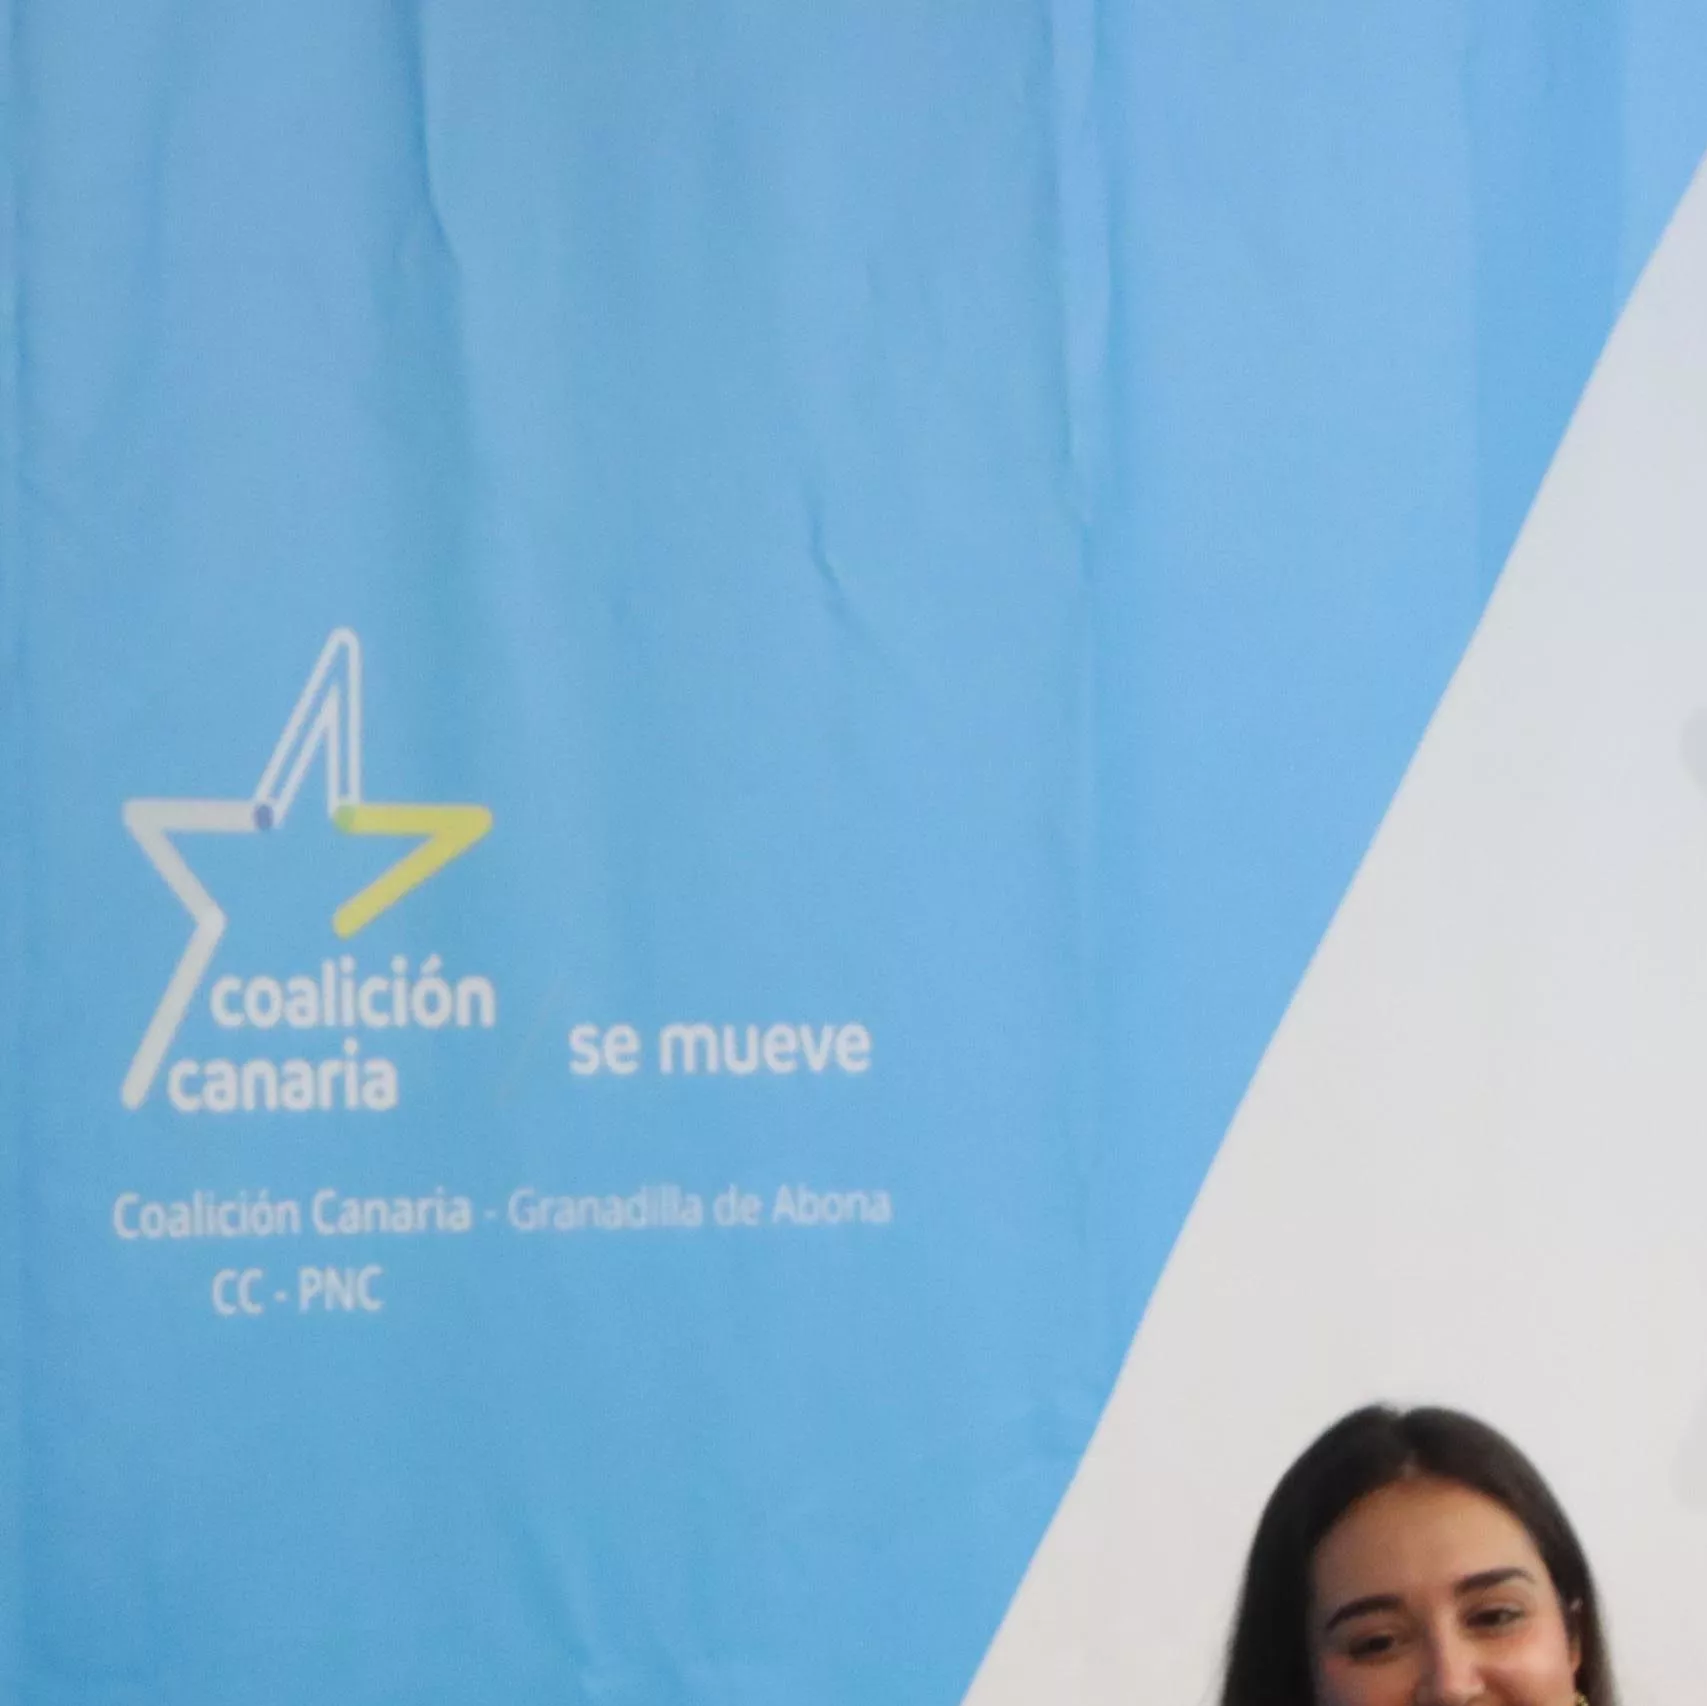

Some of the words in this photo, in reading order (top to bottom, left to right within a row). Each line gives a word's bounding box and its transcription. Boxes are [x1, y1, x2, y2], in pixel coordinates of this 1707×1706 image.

[209, 954, 497, 1029] coalición
[167, 1040, 399, 1112] canaria
[568, 1023, 641, 1076] se
[658, 1022, 873, 1075] mueve
[112, 1186, 301, 1240] Coalición
[311, 1186, 474, 1236] Canaria
[507, 1184, 705, 1233] Granadilla
[712, 1184, 763, 1227] de
[771, 1182, 893, 1226] Abona
[211, 1267, 265, 1317] CC
[298, 1265, 384, 1313] PNC
